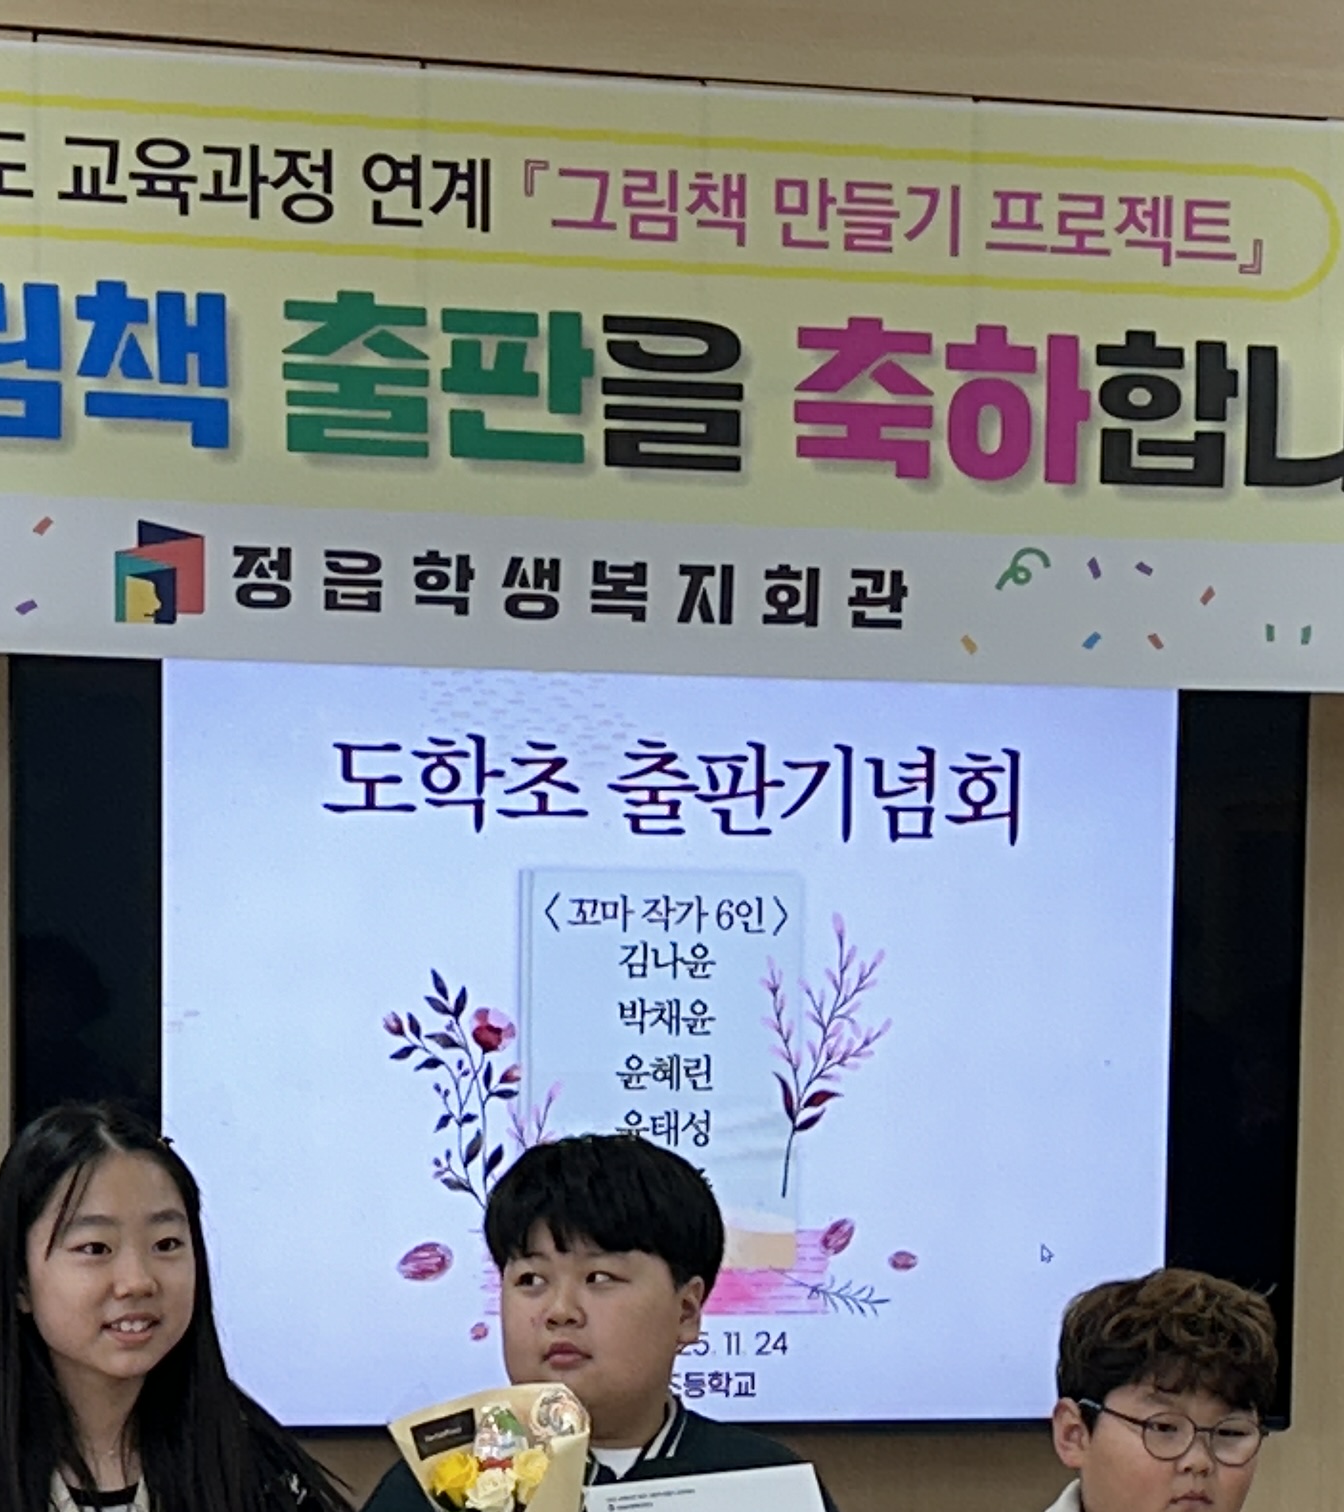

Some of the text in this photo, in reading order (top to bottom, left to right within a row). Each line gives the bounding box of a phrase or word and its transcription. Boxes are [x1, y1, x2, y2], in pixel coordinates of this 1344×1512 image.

[58, 137, 333, 224] 교육과정
[363, 153, 490, 232] 연계
[775, 178, 960, 257] 만들기
[282, 291, 743, 472] 출판을
[233, 546, 908, 629] 정읍학생복지회관
[323, 733, 1020, 846] 도학초 출판기념회
[642, 895, 708, 933] 작가
[619, 942, 716, 979] 김나윤
[619, 998, 715, 1036] 박채윤
[616, 1054, 712, 1091] 윤혜린
[755, 1331, 788, 1356] 24
